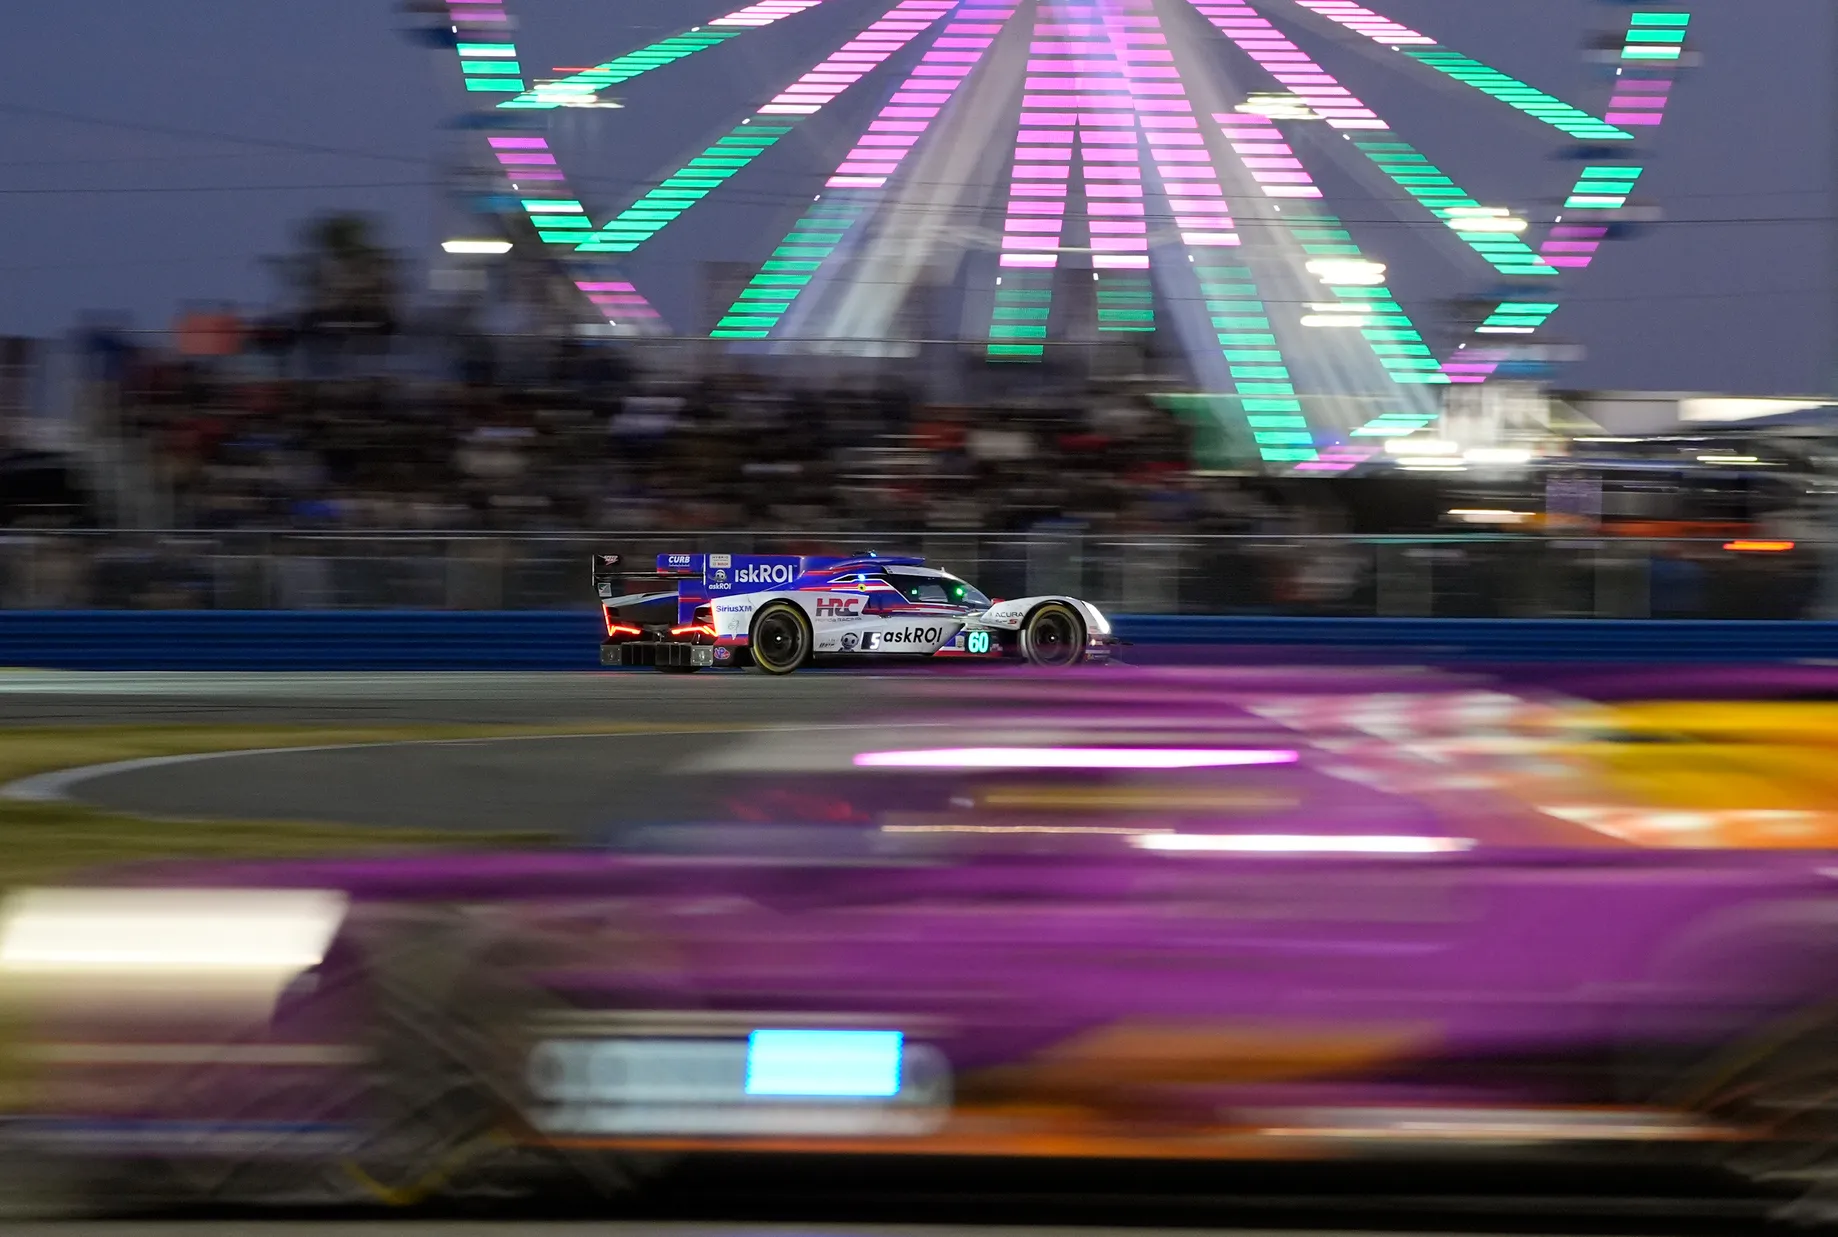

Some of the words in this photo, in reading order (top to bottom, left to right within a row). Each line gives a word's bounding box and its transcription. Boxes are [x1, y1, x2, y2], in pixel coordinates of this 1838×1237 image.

[815, 598, 859, 616] HRC
[883, 627, 943, 643] askROI
[968, 631, 989, 653] 60
